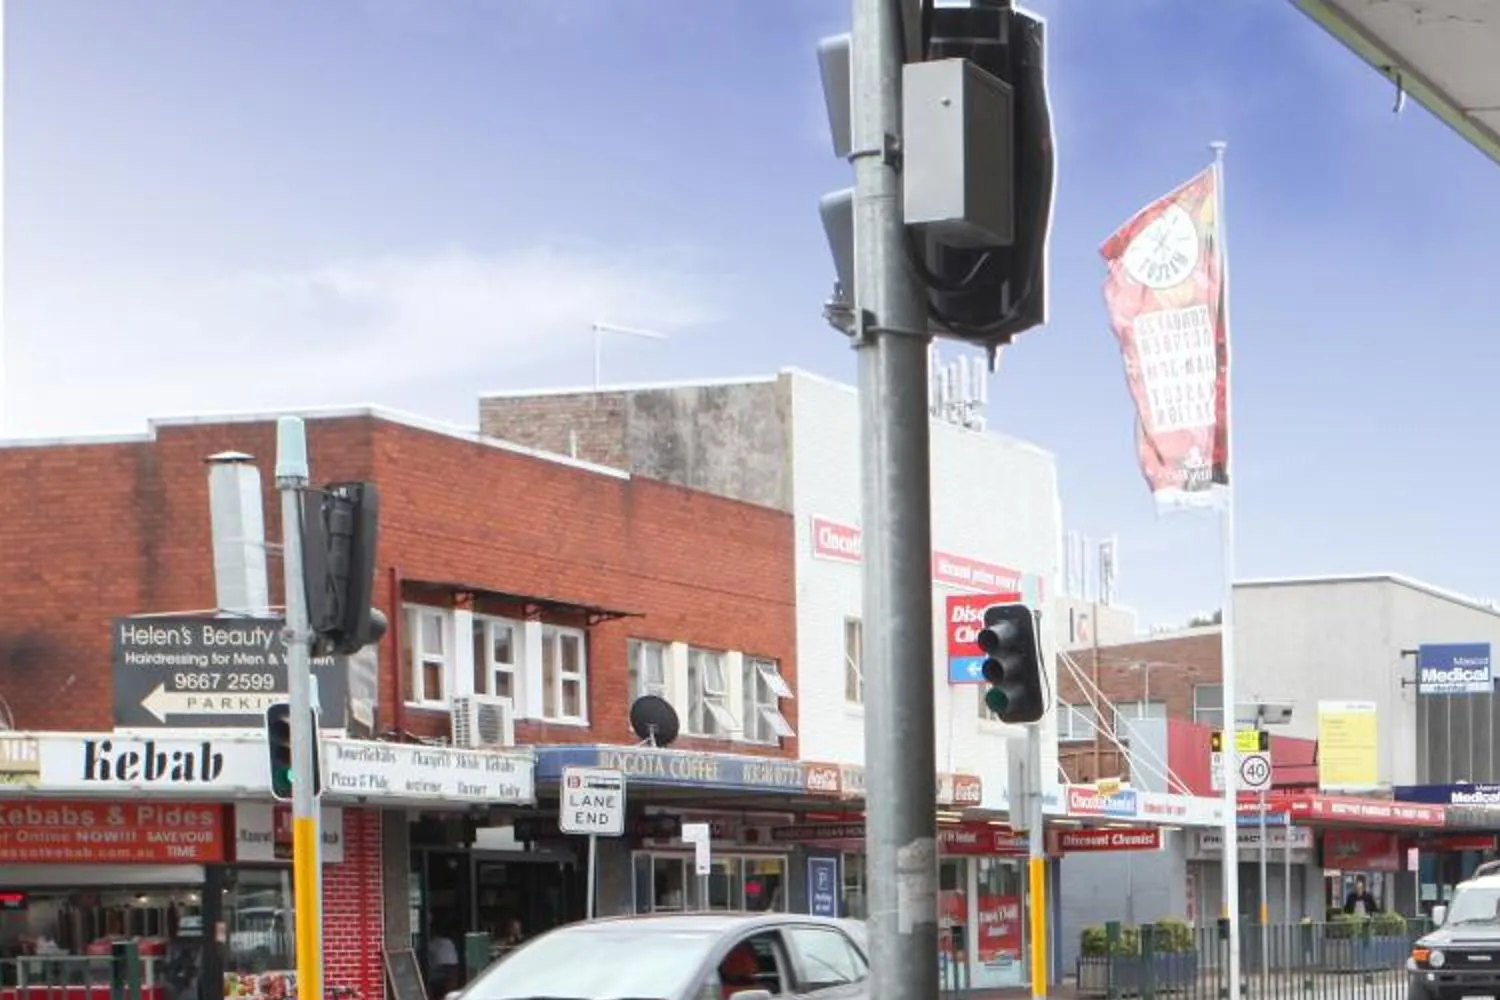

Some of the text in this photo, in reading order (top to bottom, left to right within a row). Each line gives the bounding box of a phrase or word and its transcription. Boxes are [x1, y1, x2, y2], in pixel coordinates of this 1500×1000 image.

[121, 626, 273, 650] Helen's Beauty
[124, 652, 208, 667] Hairdressing
[212, 652, 230, 665] for
[233, 653, 264, 666] Men
[268, 654, 279, 666] &
[174, 673, 275, 690] 9667 2599
[1421, 667, 1489, 683] Medical
[81, 738, 224, 782] Kebab
[600, 751, 667, 777] BOGOTA
[669, 757, 720, 781] COFFEE
[1246, 763, 1265, 777] 40
[569, 795, 616, 809] LANE
[108, 805, 124, 825] &
[138, 806, 213, 826] Pides
[575, 812, 609, 825] END
[1062, 832, 1155, 847] Discount Chemist
[1202, 832, 1262, 844] PHAMACY
[167, 845, 196, 857] TIME
